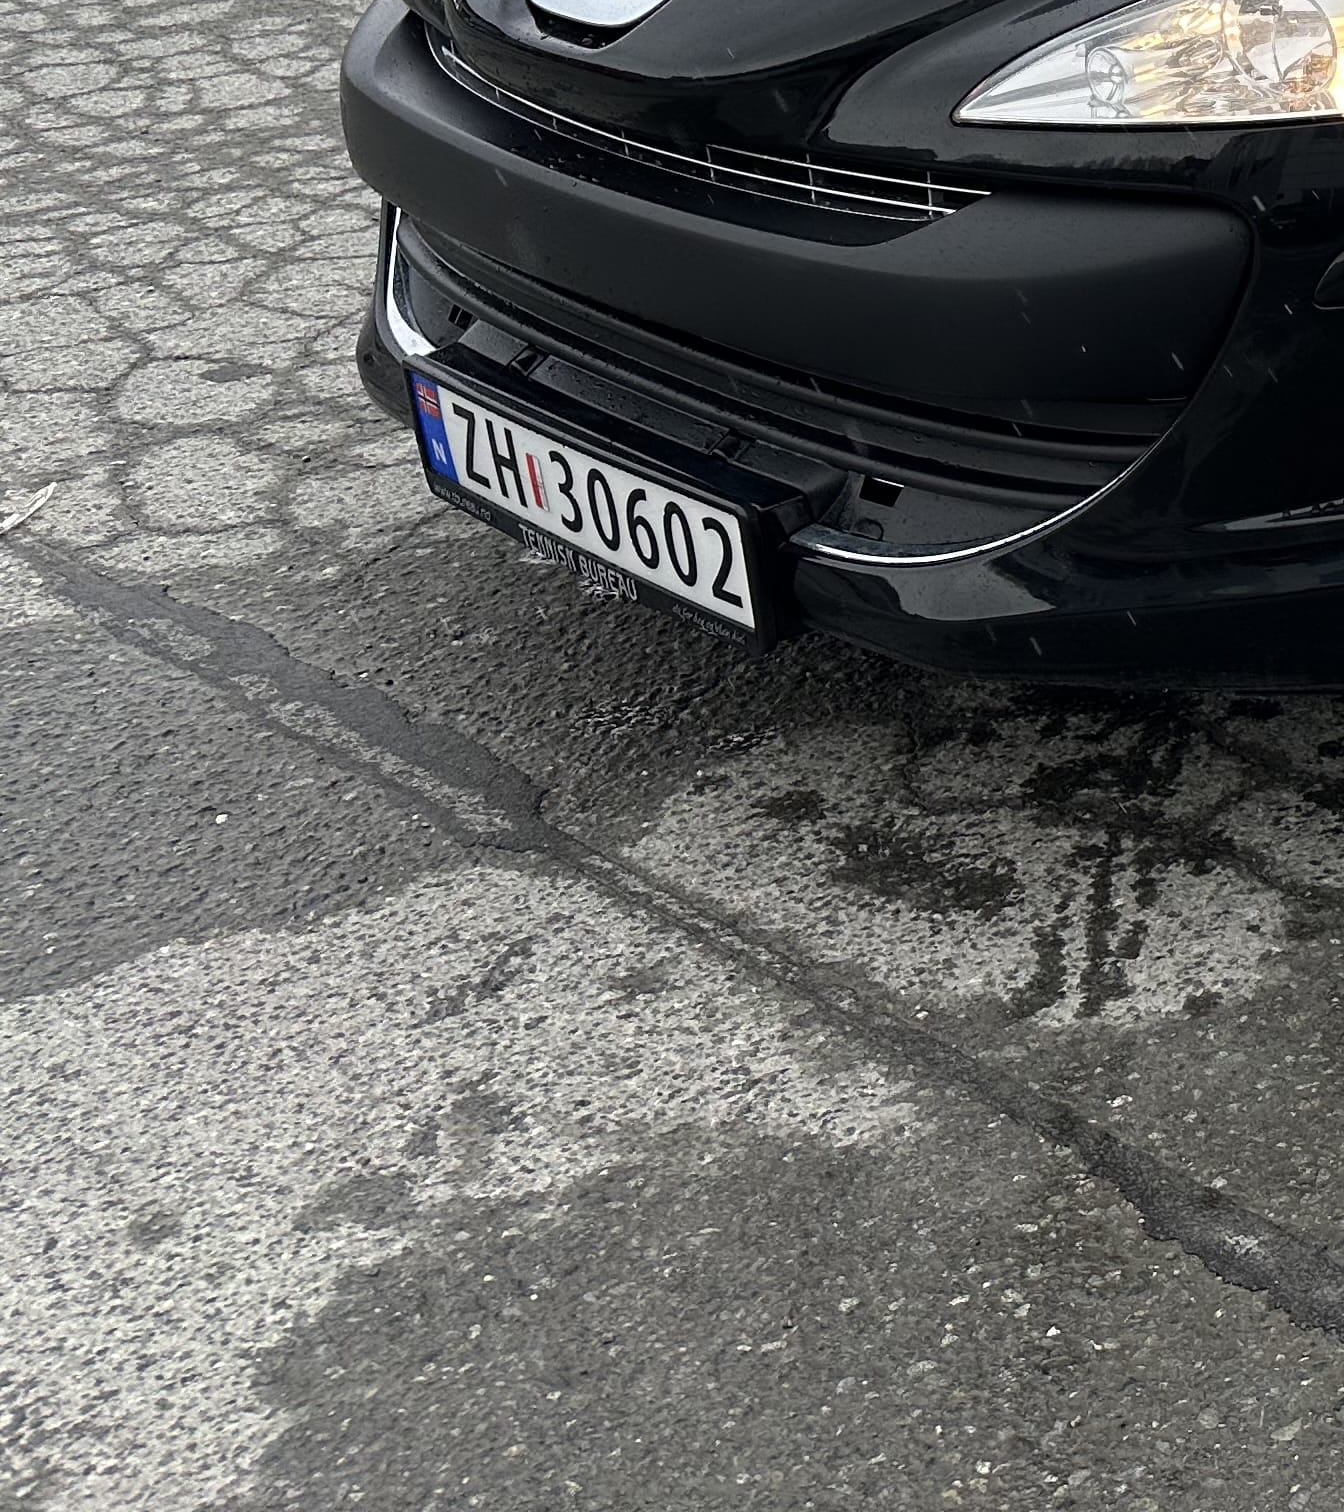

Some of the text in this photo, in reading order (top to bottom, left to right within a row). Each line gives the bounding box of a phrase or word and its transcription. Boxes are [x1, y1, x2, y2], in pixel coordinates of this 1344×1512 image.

[431, 437, 447, 466] N
[451, 402, 744, 609] ZH 30602
[579, 558, 638, 602] BUREAU
